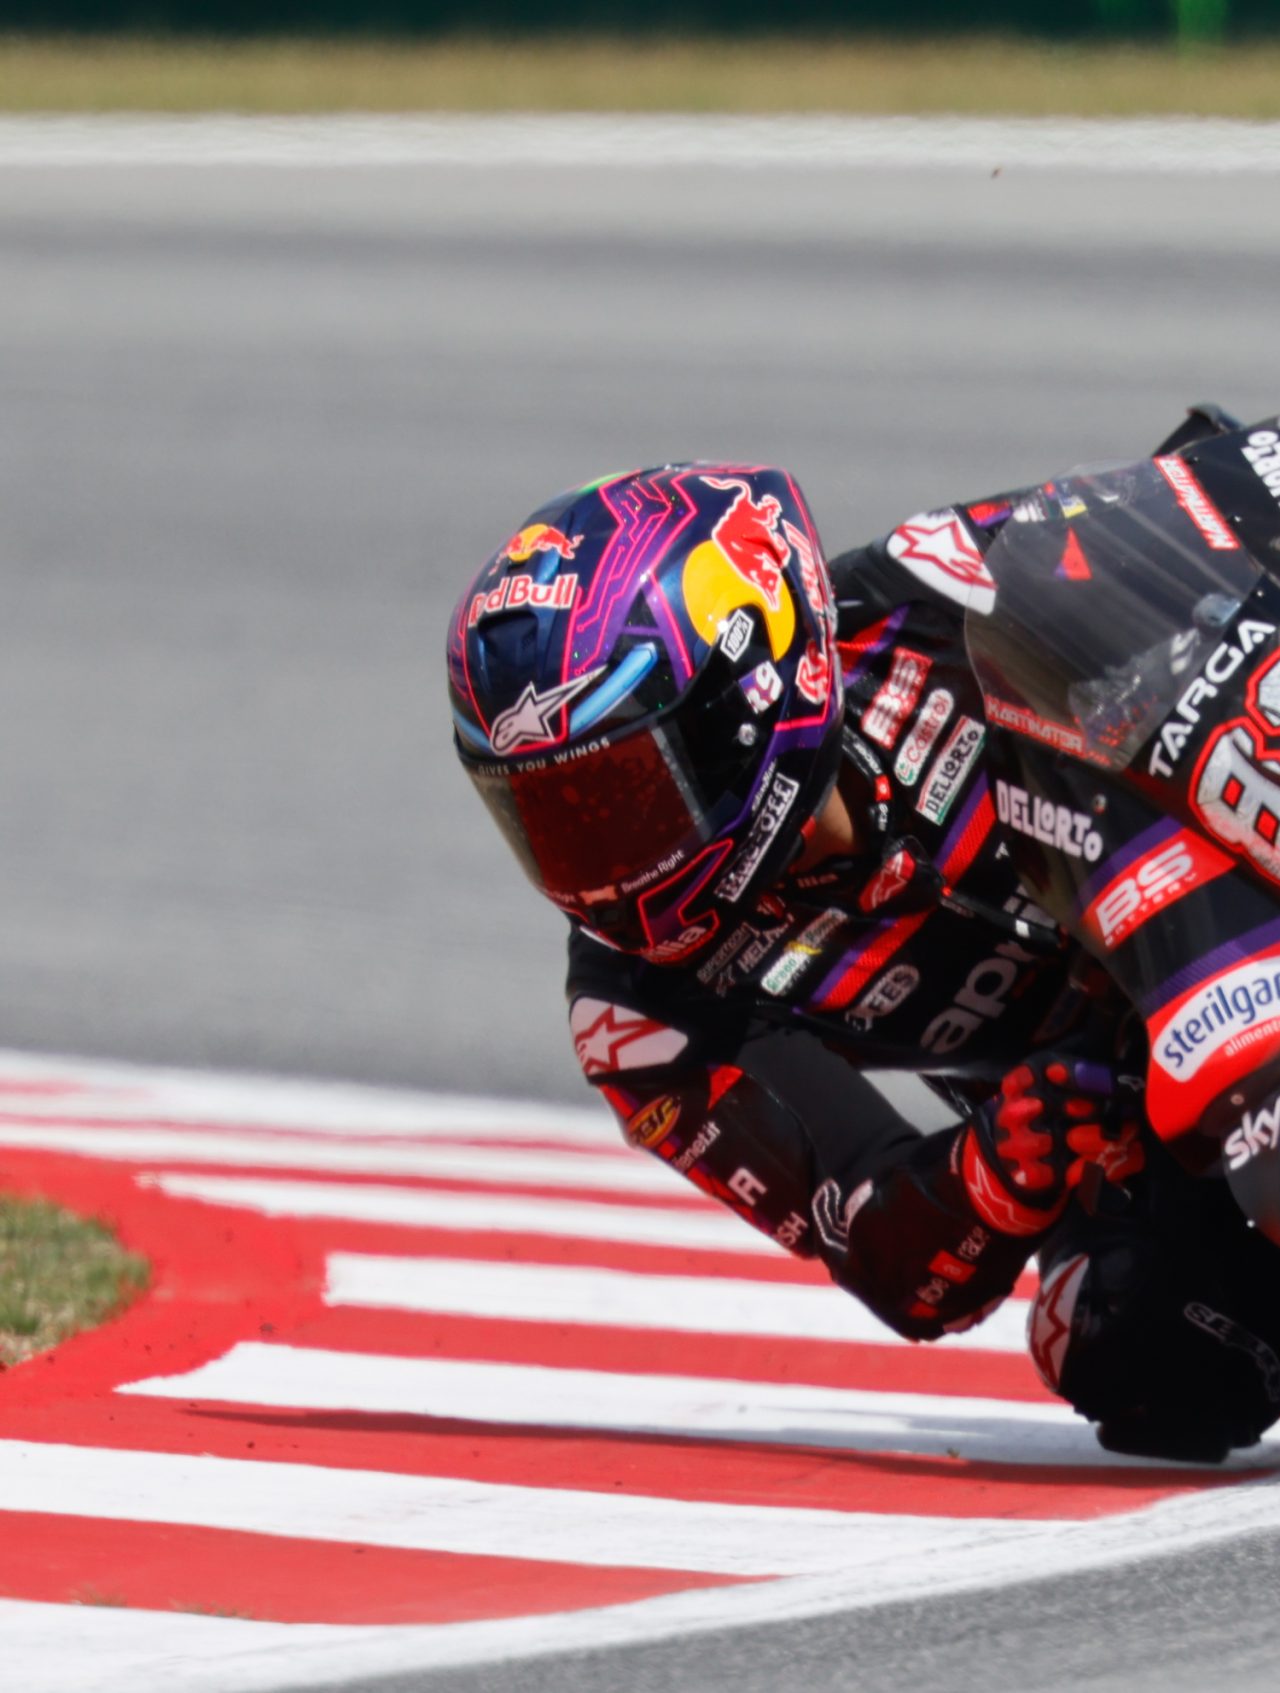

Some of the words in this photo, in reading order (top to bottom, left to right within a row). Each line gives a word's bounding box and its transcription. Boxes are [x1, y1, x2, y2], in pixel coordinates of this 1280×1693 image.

[506, 573, 578, 609] Bull
[726, 614, 749, 656] 100%
[863, 659, 919, 739] BS
[1149, 619, 1276, 777] TARGA
[477, 760, 510, 777] GIVES
[516, 760, 547, 775] YOU
[554, 738, 612, 765] WINGS
[905, 695, 949, 763] Castrol
[621, 864, 659, 894] Breathe
[658, 848, 684, 878] Right
[1097, 842, 1194, 937] BS
